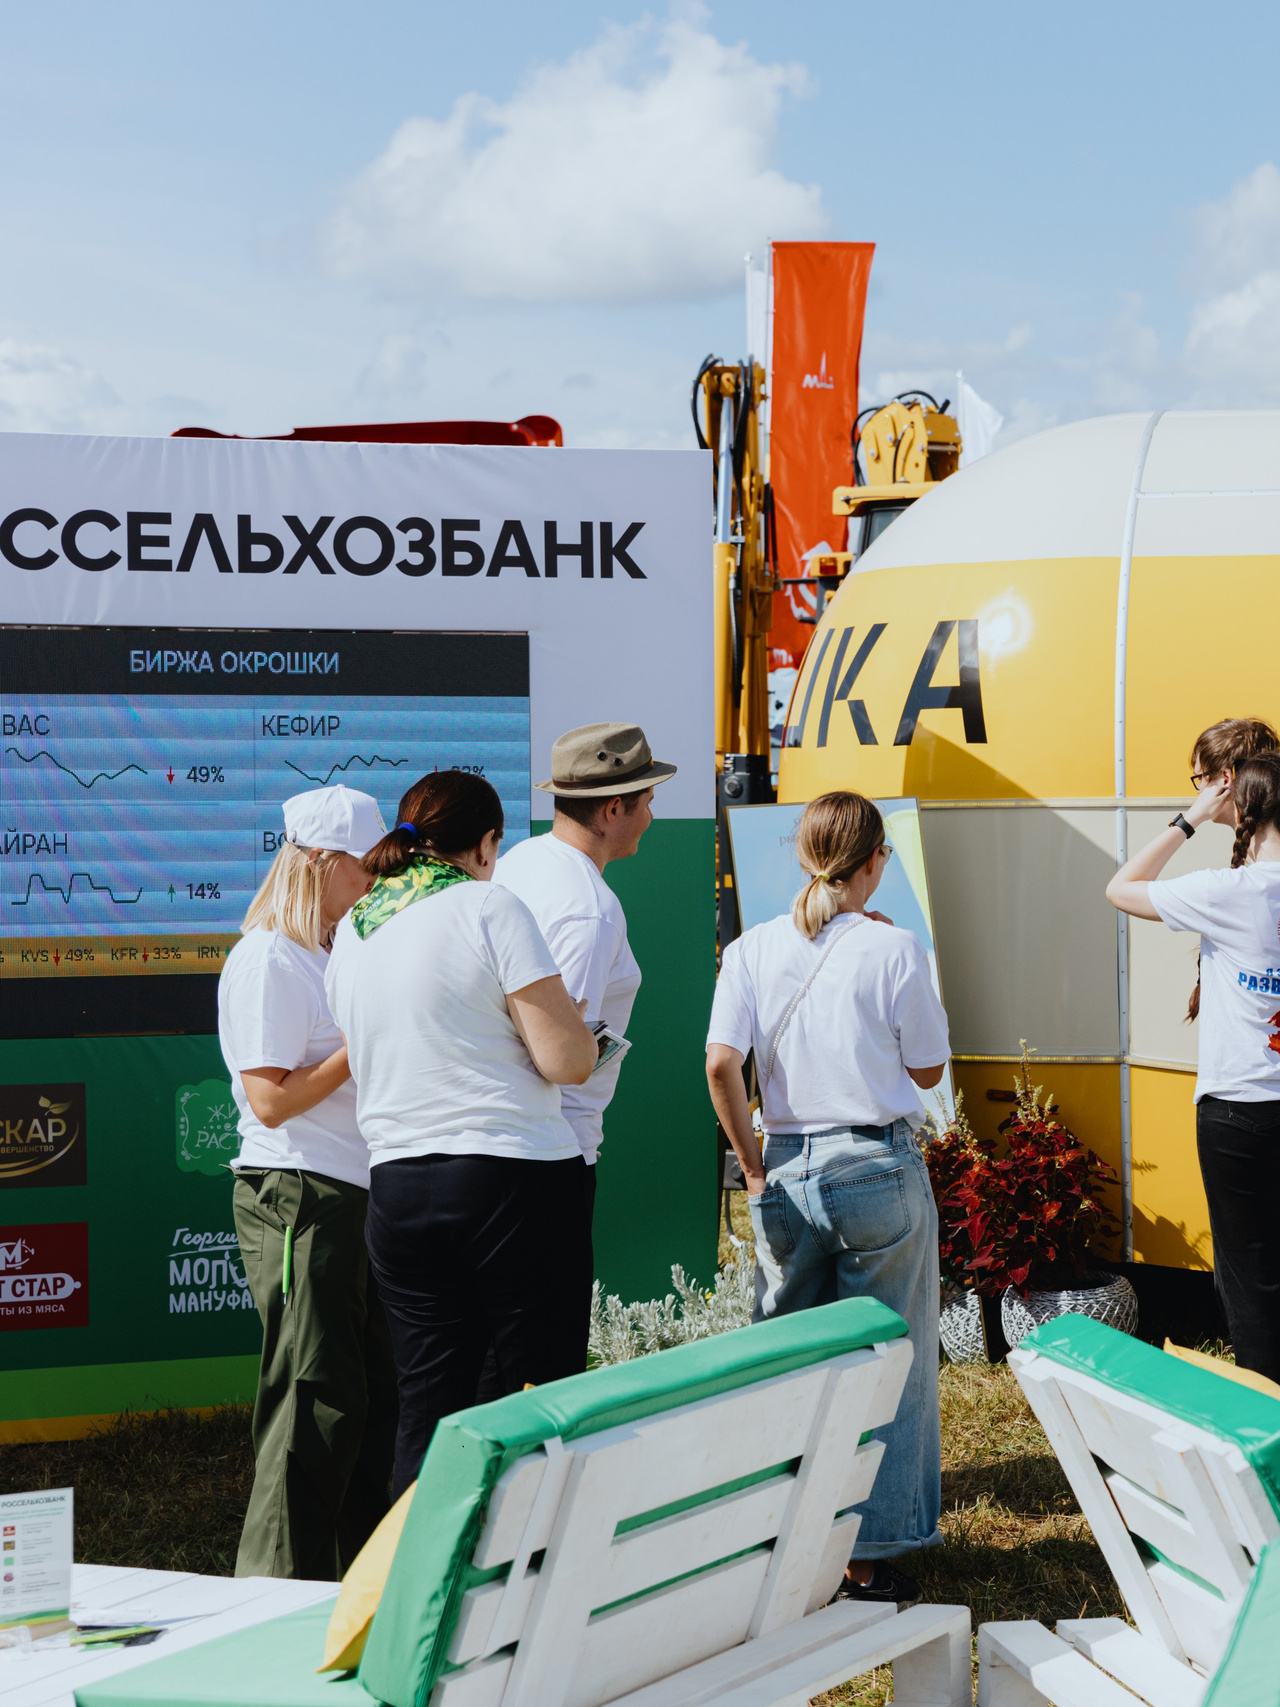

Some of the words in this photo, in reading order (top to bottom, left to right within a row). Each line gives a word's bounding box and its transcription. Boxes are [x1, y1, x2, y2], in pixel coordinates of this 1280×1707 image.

[129, 650, 214, 673] БИРЖА
[220, 651, 340, 675] ОКРОШКИ
[262, 714, 341, 737] КЕФИР
[186, 766, 225, 783] 49%
[0, 828, 68, 855] ЙРАН
[186, 882, 221, 900] 14%
[21, 949, 49, 963] KVS
[64, 948, 95, 962] 49%
[111, 947, 137, 961] KFR
[153, 946, 182, 960] 33%
[11, 1276, 66, 1298] СТАР
[18, 1305, 33, 1315] ИЗ
[35, 1303, 66, 1314] МЯСА
[169, 1289, 258, 1314] МАНУФА
